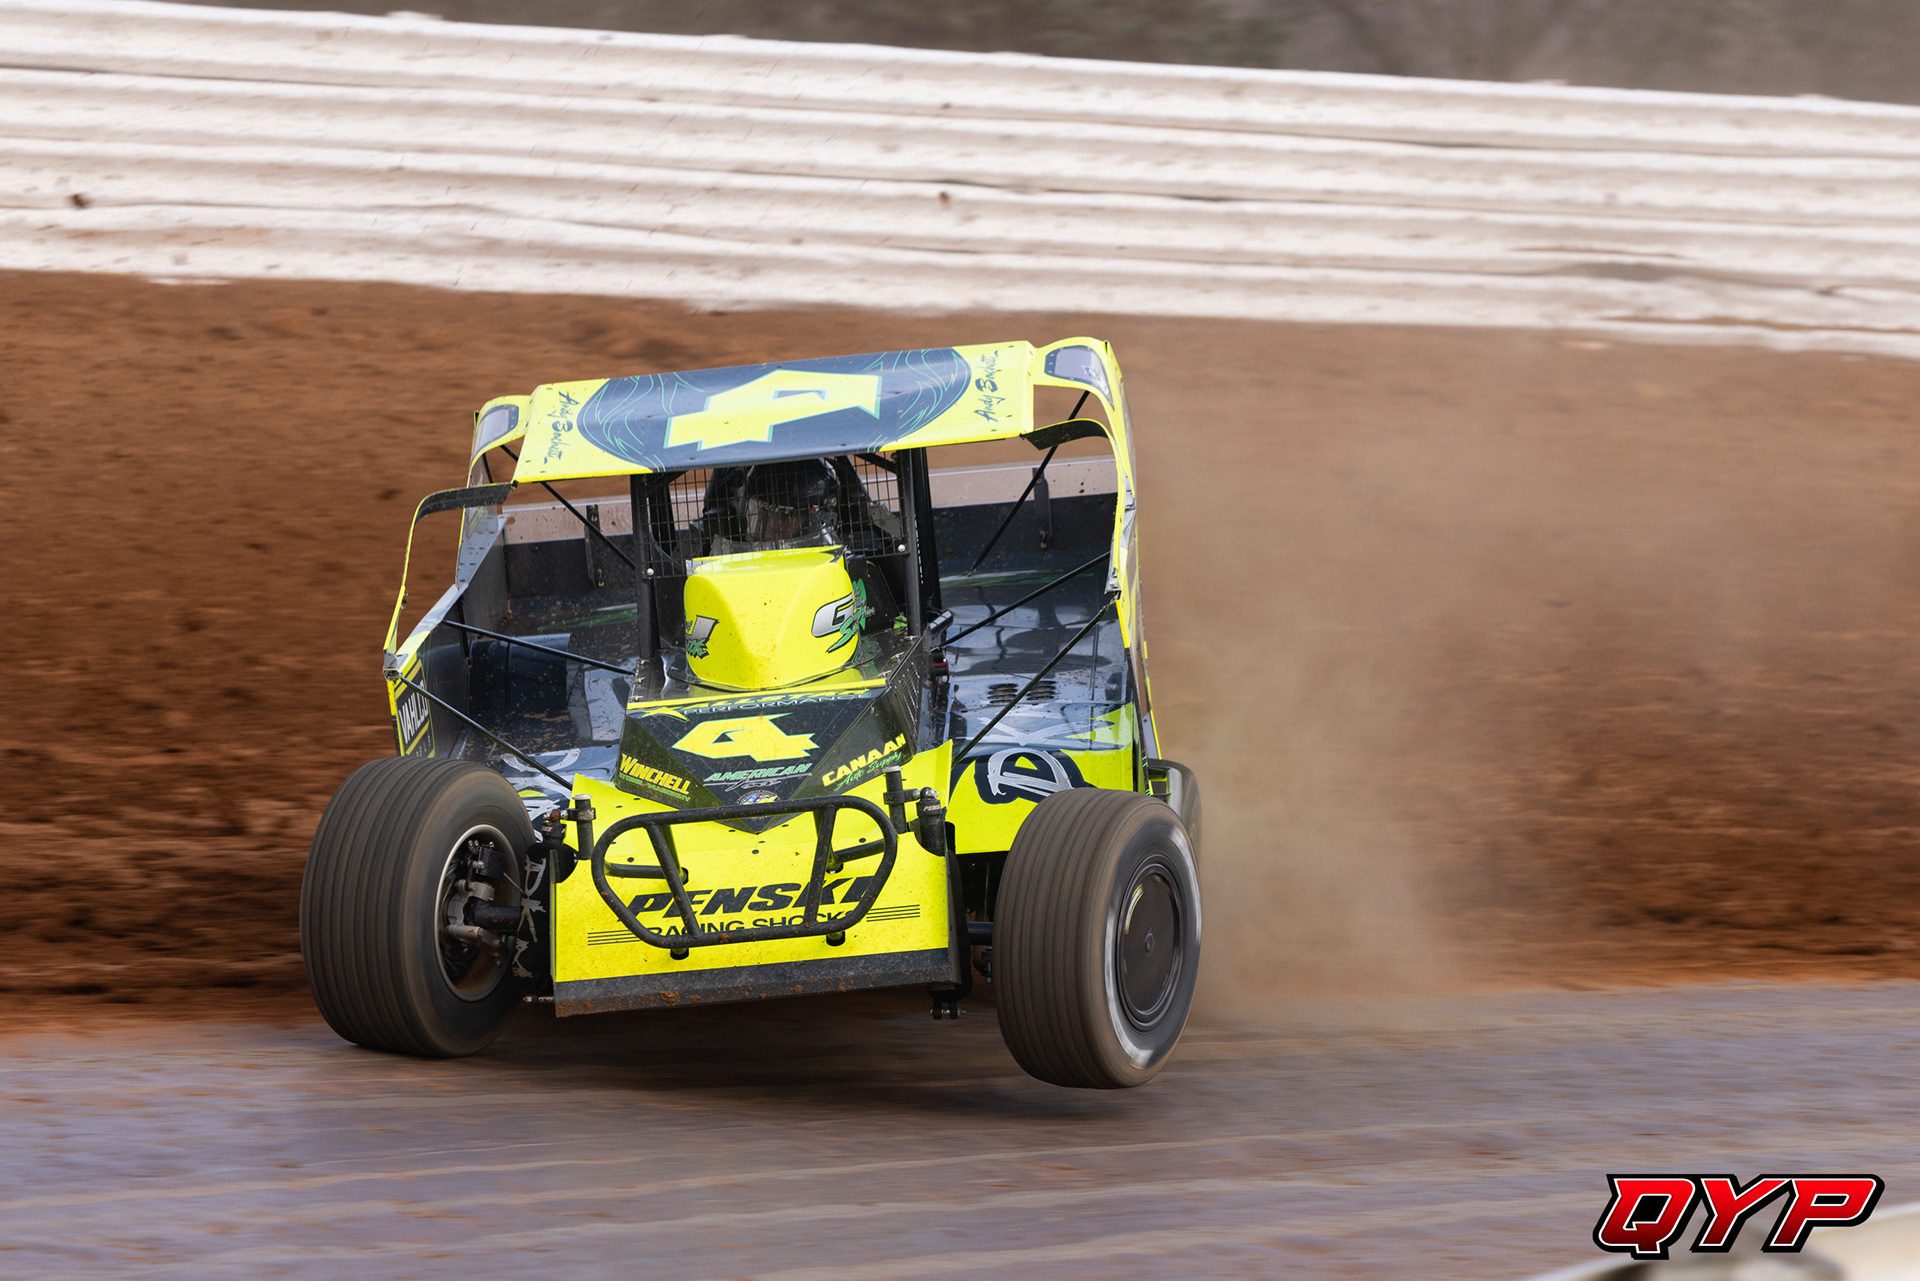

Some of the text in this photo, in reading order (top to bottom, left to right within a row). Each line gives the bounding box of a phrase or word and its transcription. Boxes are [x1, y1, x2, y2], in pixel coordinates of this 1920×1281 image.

[547, 391, 580, 419] Andy
[663, 369, 883, 452] 4
[973, 395, 1006, 423] Andy
[683, 693, 871, 715] PERFORMANCE
[671, 712, 820, 762] 4
[619, 752, 692, 796] WINCHELL
[703, 762, 813, 782] AMERICAN
[821, 732, 907, 787] CANAAN
[833, 751, 902, 792] Auto Supply
